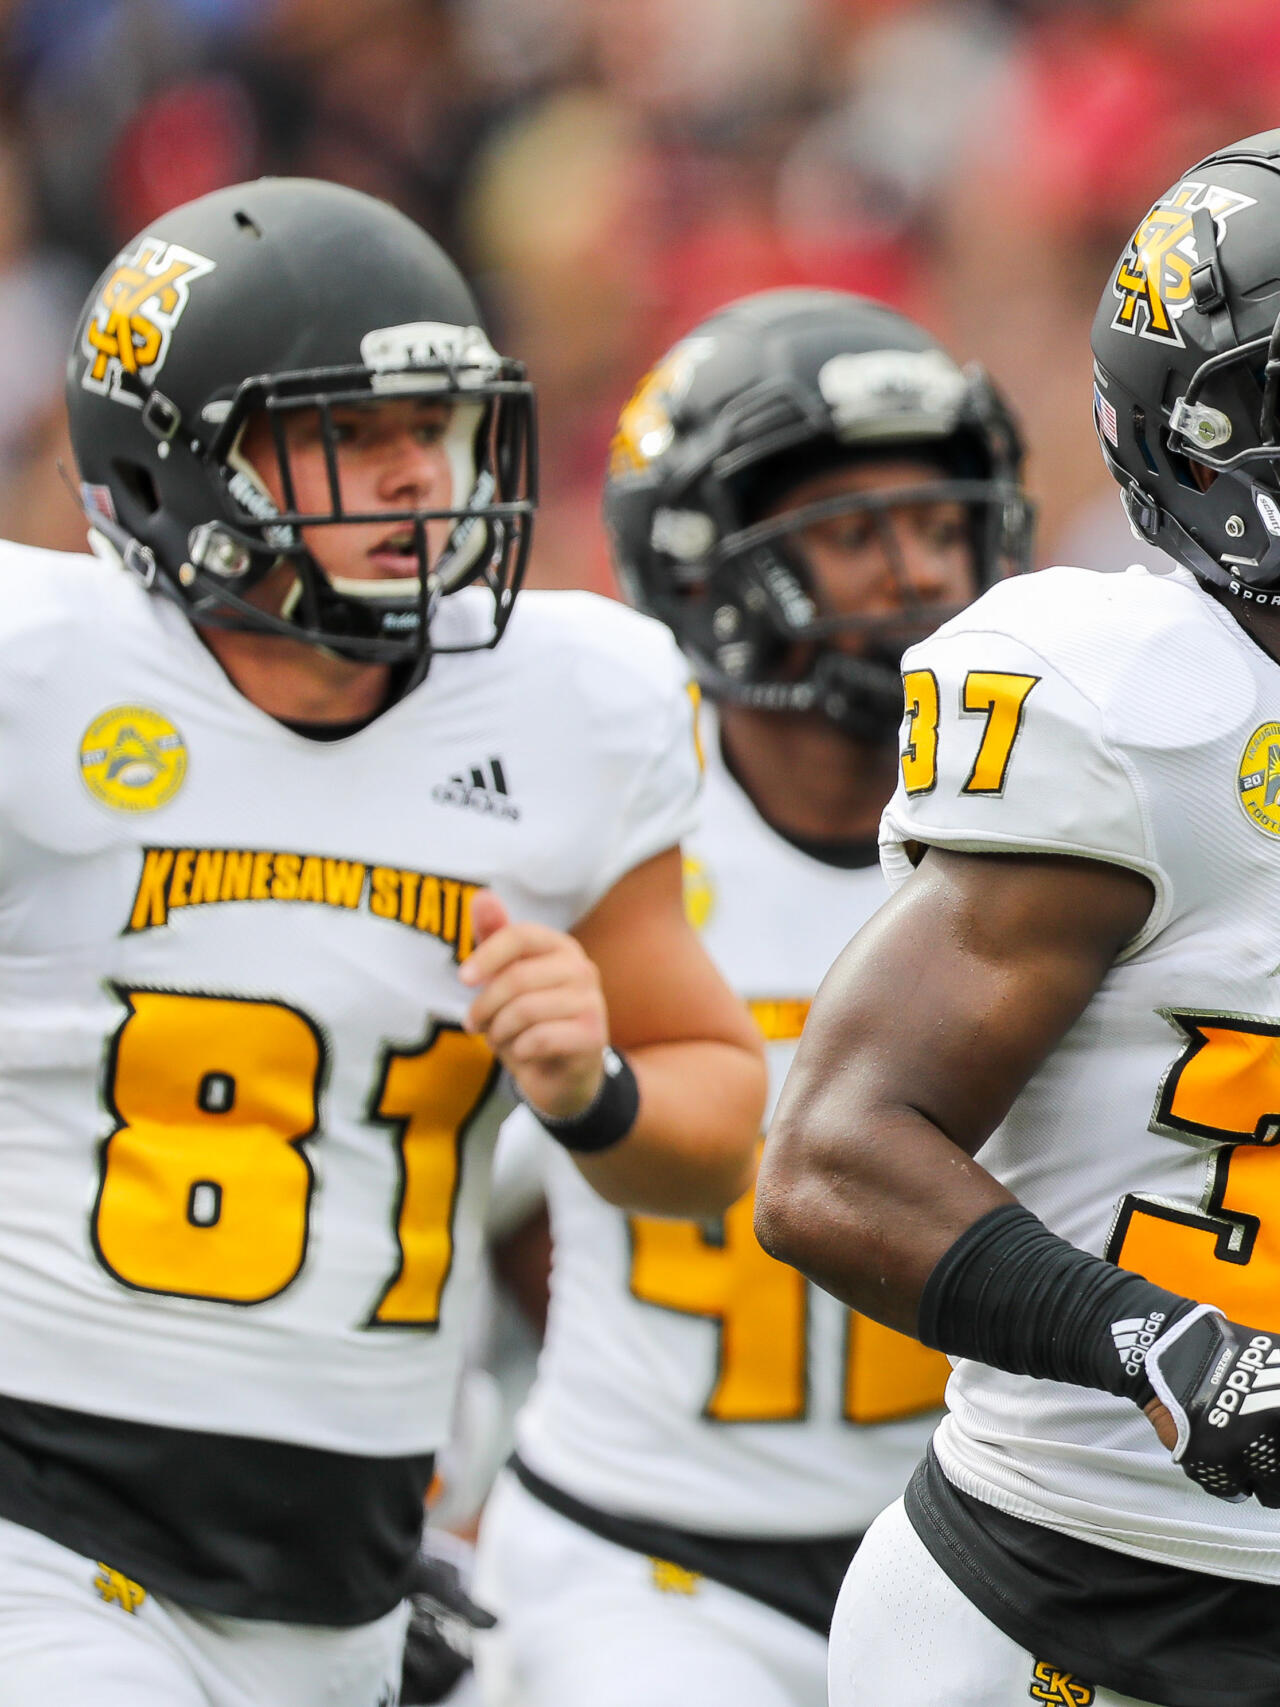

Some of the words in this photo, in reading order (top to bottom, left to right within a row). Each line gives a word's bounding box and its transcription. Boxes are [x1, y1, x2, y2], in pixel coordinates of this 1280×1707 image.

[1259, 498, 1280, 530] schutt
[901, 669, 1042, 799] 37
[1243, 774, 1262, 790] 20
[126, 848, 366, 932] KENNESAW
[91, 982, 498, 1330] 81
[1124, 1311, 1166, 1376] adidas
[1208, 1336, 1273, 1428] adidas
